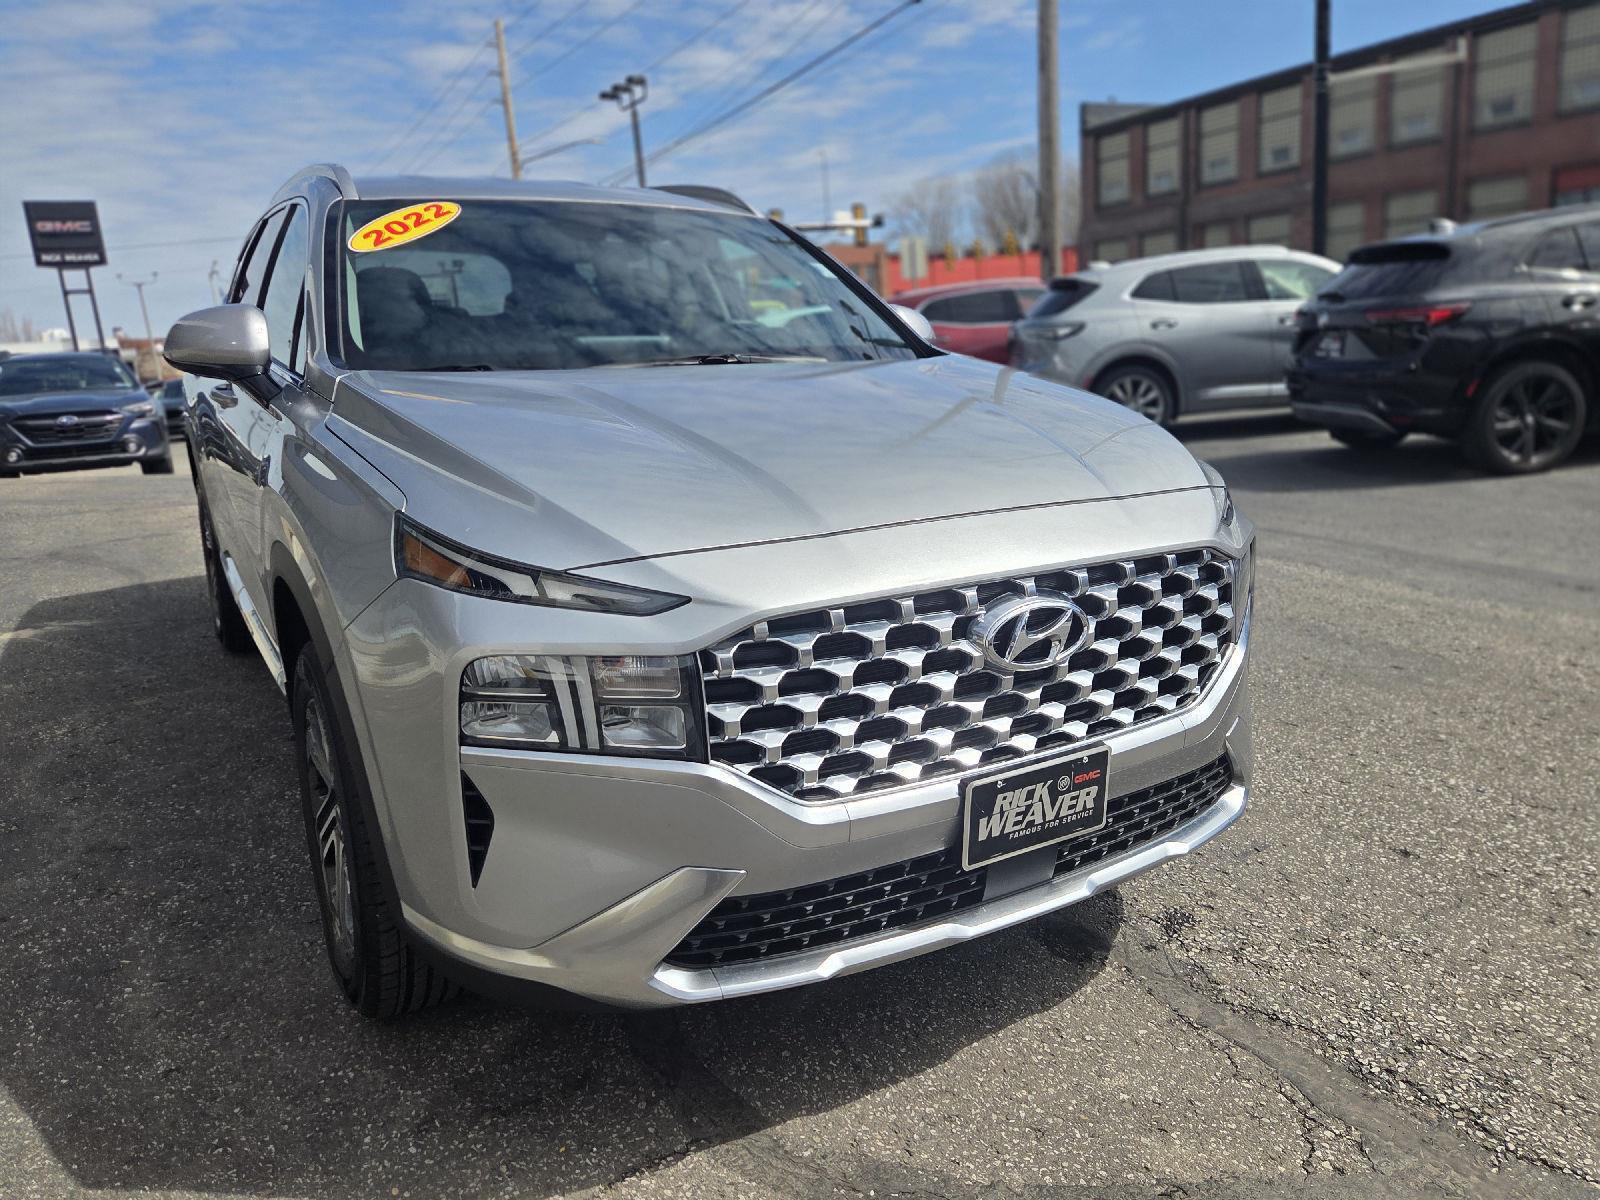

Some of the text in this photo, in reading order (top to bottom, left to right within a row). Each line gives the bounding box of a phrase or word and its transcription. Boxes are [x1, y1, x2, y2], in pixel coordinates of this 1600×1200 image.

[36, 221, 92, 232] GMC
[363, 204, 452, 248] 2022
[1074, 769, 1101, 784] GMC
[978, 785, 1099, 842] WEAVER
[992, 779, 1054, 815] RICK
[1009, 810, 1094, 840] FAMOUS FOR SERVICE
